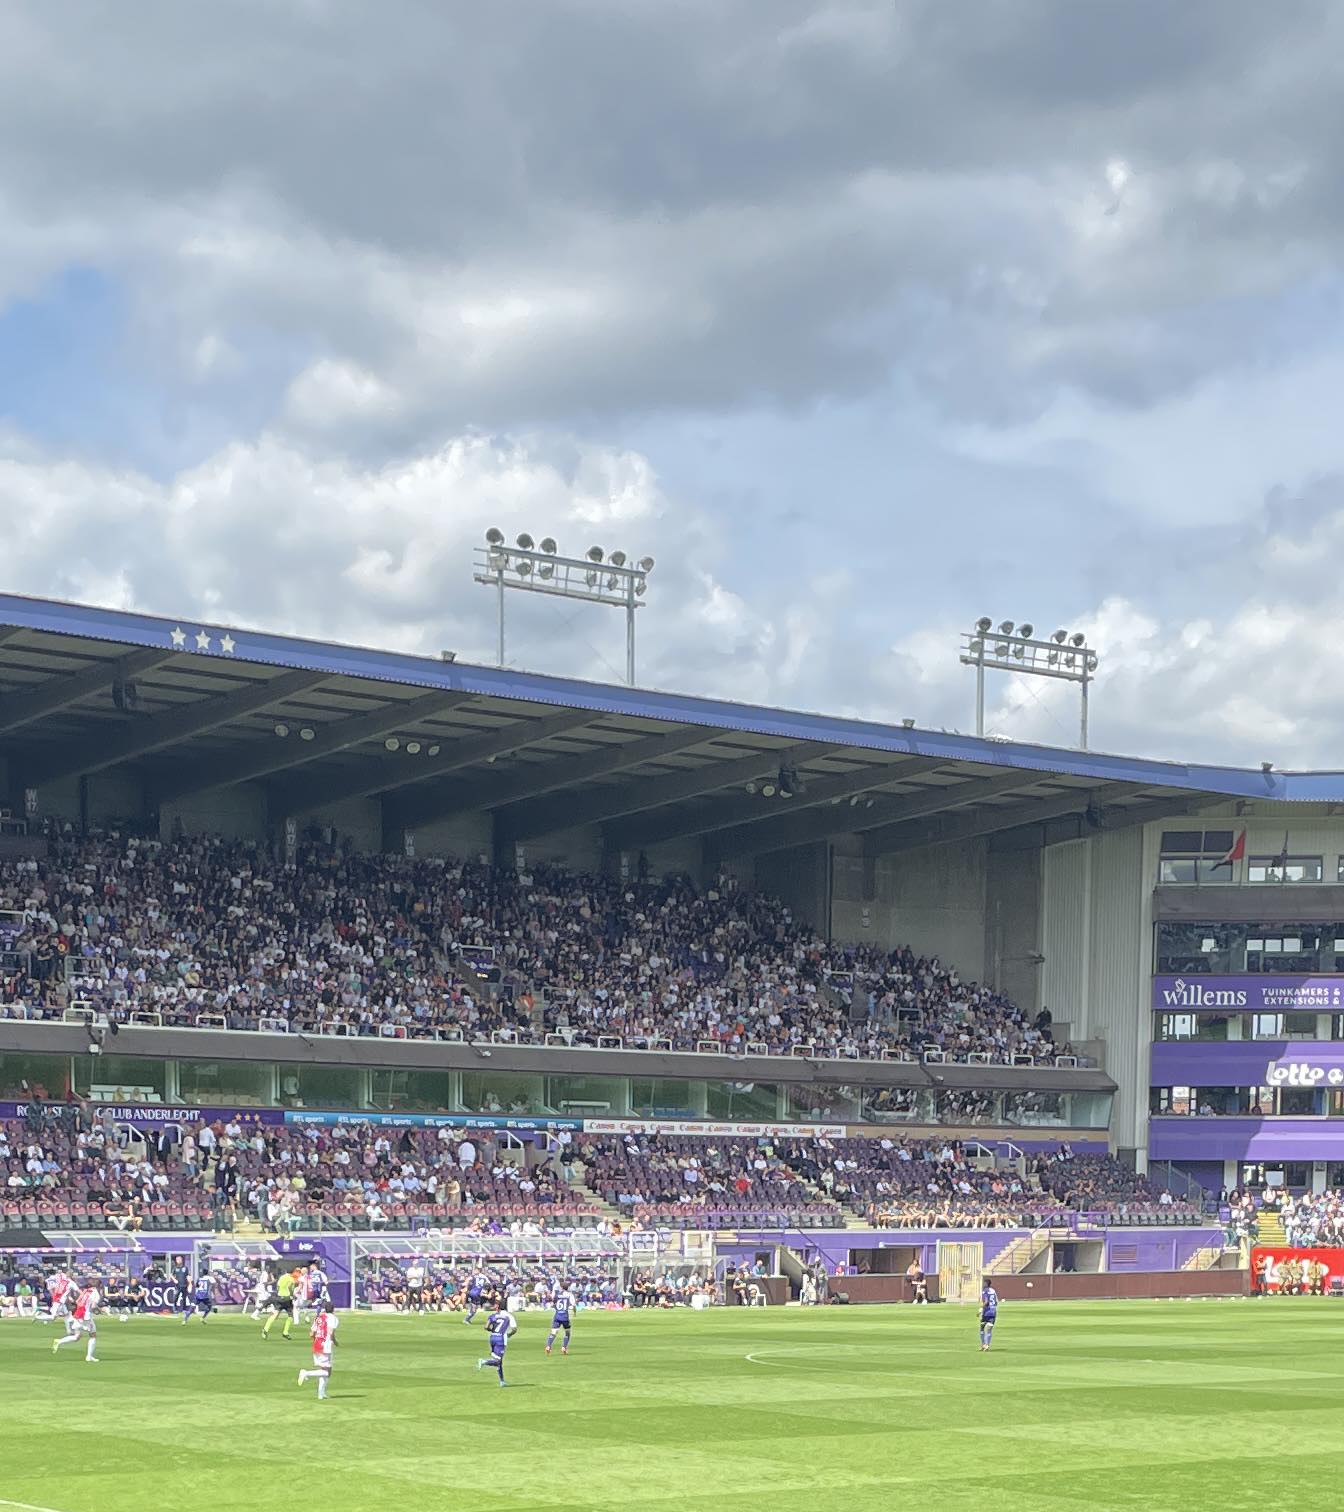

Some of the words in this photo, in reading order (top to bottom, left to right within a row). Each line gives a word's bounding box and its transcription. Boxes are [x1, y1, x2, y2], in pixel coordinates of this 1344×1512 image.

[1163, 981, 1247, 1006] willems
[1262, 987, 1329, 996] TUINKAMERS
[1264, 997, 1330, 1005] EXTENSIONS
[133, 1108, 201, 1121] ANDERLECHT
[557, 1299, 566, 1310] 61
[494, 1320, 503, 1332] 7
